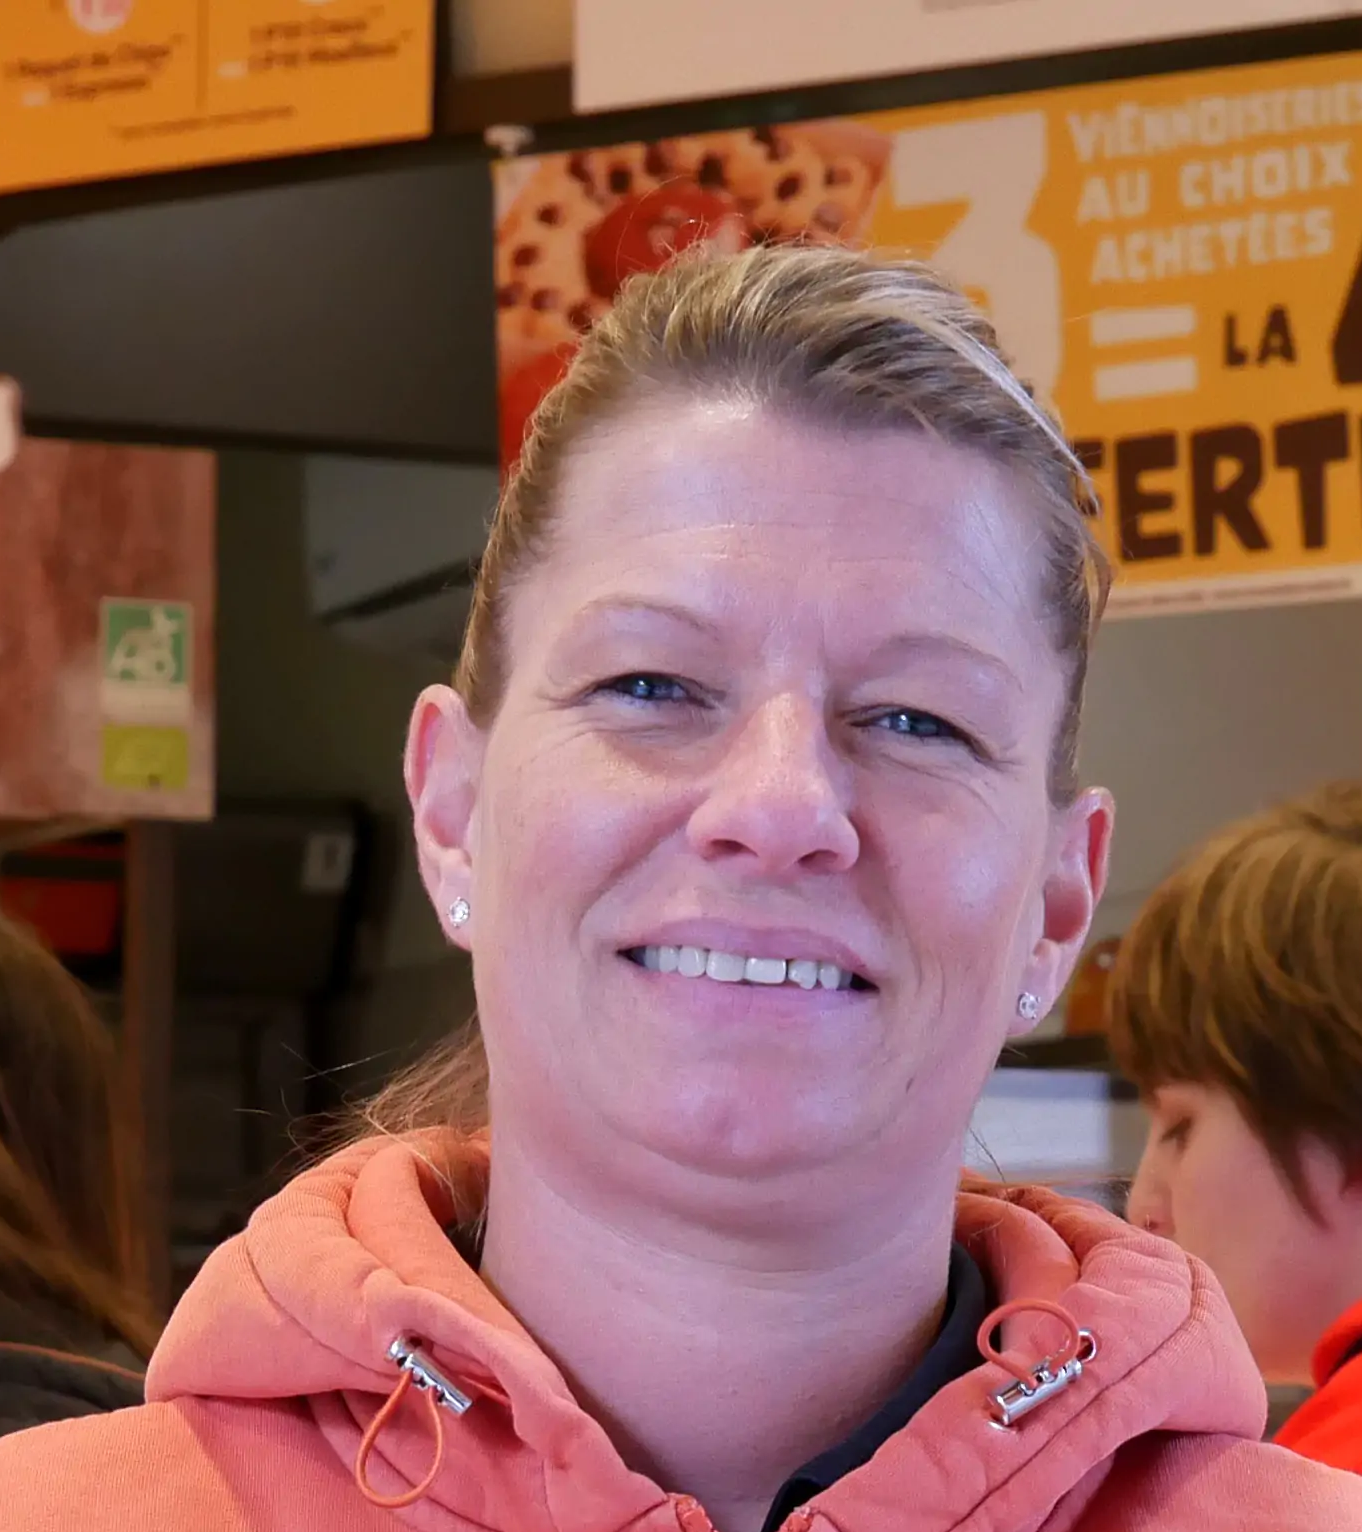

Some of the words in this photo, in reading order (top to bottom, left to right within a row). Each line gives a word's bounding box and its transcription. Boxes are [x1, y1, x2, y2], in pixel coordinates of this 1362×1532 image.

[1078, 168, 1151, 226] AU
[1179, 140, 1353, 208] CHOIX
[1222, 304, 1297, 368] LA
